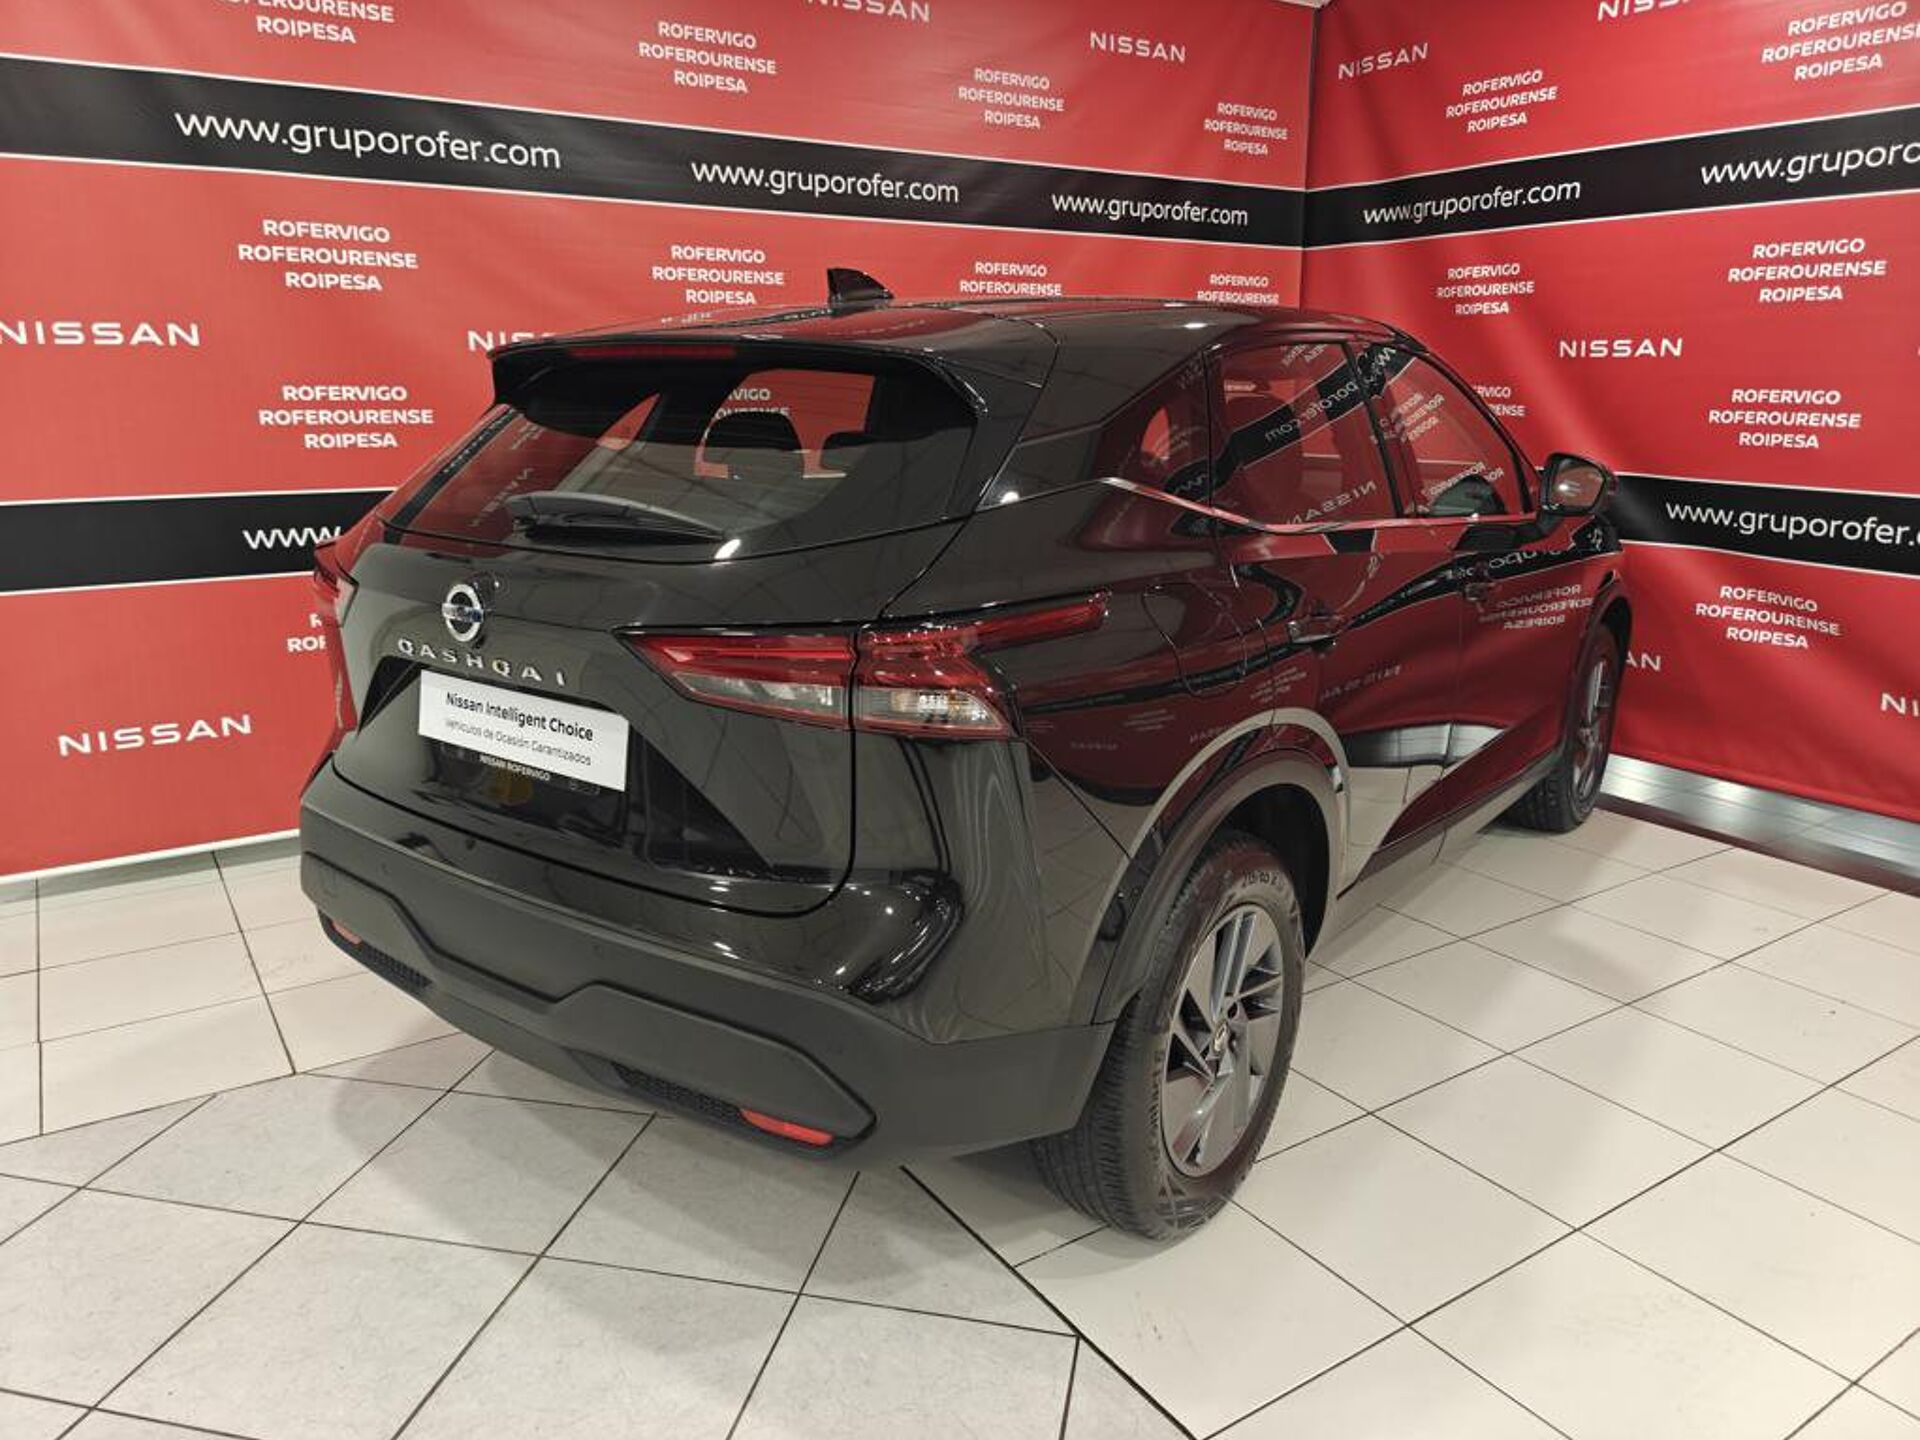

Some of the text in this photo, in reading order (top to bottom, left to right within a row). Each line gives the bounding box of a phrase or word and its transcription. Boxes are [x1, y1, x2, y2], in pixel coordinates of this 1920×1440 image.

[226, 0, 394, 22] ROURENSE
[807, 0, 930, 22] SSAN
[1597, 0, 1690, 21] NIS
[1788, 2, 1907, 37] ROFERVIGO
[256, 16, 356, 43] ROIPESA
[657, 21, 757, 50] ROFERVIGO
[1090, 31, 1186, 62] NISSAN
[638, 42, 777, 75] ROFEROURENSE
[1338, 43, 1429, 80] NISSAN
[1794, 53, 1884, 81] ROIPESA
[674, 69, 748, 93] ROIPESA
[974, 67, 1050, 90] ROFERVIGO
[1462, 69, 1543, 97] ROFERVIGO
[958, 85, 1064, 113] ROFEROURENSE
[1446, 86, 1557, 118] ROFEROURENSE
[983, 110, 1040, 130] ROIPESA
[1217, 101, 1278, 122] ROFERVIGO
[1467, 112, 1528, 133] ROIPESA
[1204, 118, 1288, 141] ROFEROURENSE
[174, 112, 562, 170] www.gruporofer.com
[1223, 138, 1269, 156] ROIPESA
[691, 160, 959, 204] www.gruporofer.com
[1052, 193, 1249, 227] www.gruporofer.com
[1364, 179, 1581, 224] www.gruporofer.com
[262, 219, 391, 244] ROFERVIGO
[237, 243, 419, 270] ROFEROURENSE
[671, 245, 765, 264] ROFERVIGO
[1753, 238, 1865, 259] ROFERVIGO
[652, 266, 784, 286] ROFEROURENSE
[975, 261, 1047, 277] ROFERVIGO
[1447, 263, 1521, 280] ROFERVIGO
[1728, 260, 1887, 283] ROFEROURENSE
[284, 271, 383, 291] ROIPESA
[960, 280, 1062, 296] ROFEROURENSE
[1209, 273, 1269, 288] ROFERVIGO
[1437, 280, 1535, 298] ROFEROURENSE
[686, 289, 756, 306] ROIPESA
[1759, 286, 1843, 303] ROIPESA
[1454, 301, 1509, 315] ROIPESA
[0, 321, 201, 347] NISSAN
[1560, 338, 1683, 358] NISSAN
[282, 385, 408, 402] ROFERVIGO
[1731, 388, 1841, 406] ROFERVIGO
[258, 409, 434, 426] ROFEROURENSE
[1708, 409, 1861, 428] ROFEROURENSE
[303, 432, 398, 449] ROIPESA
[1738, 431, 1819, 449] ROIPESA
[1665, 501, 1920, 548] www.gruporofer.
[1719, 585, 1818, 612] ROFERVIGO
[1695, 602, 1841, 636] ROFEROURENSE
[1725, 627, 1809, 649] ROIPESA
[397, 638, 566, 687] QASHQAI
[446, 692, 593, 741] Nissan Intelligent Choice
[58, 714, 252, 757] NISSAN
